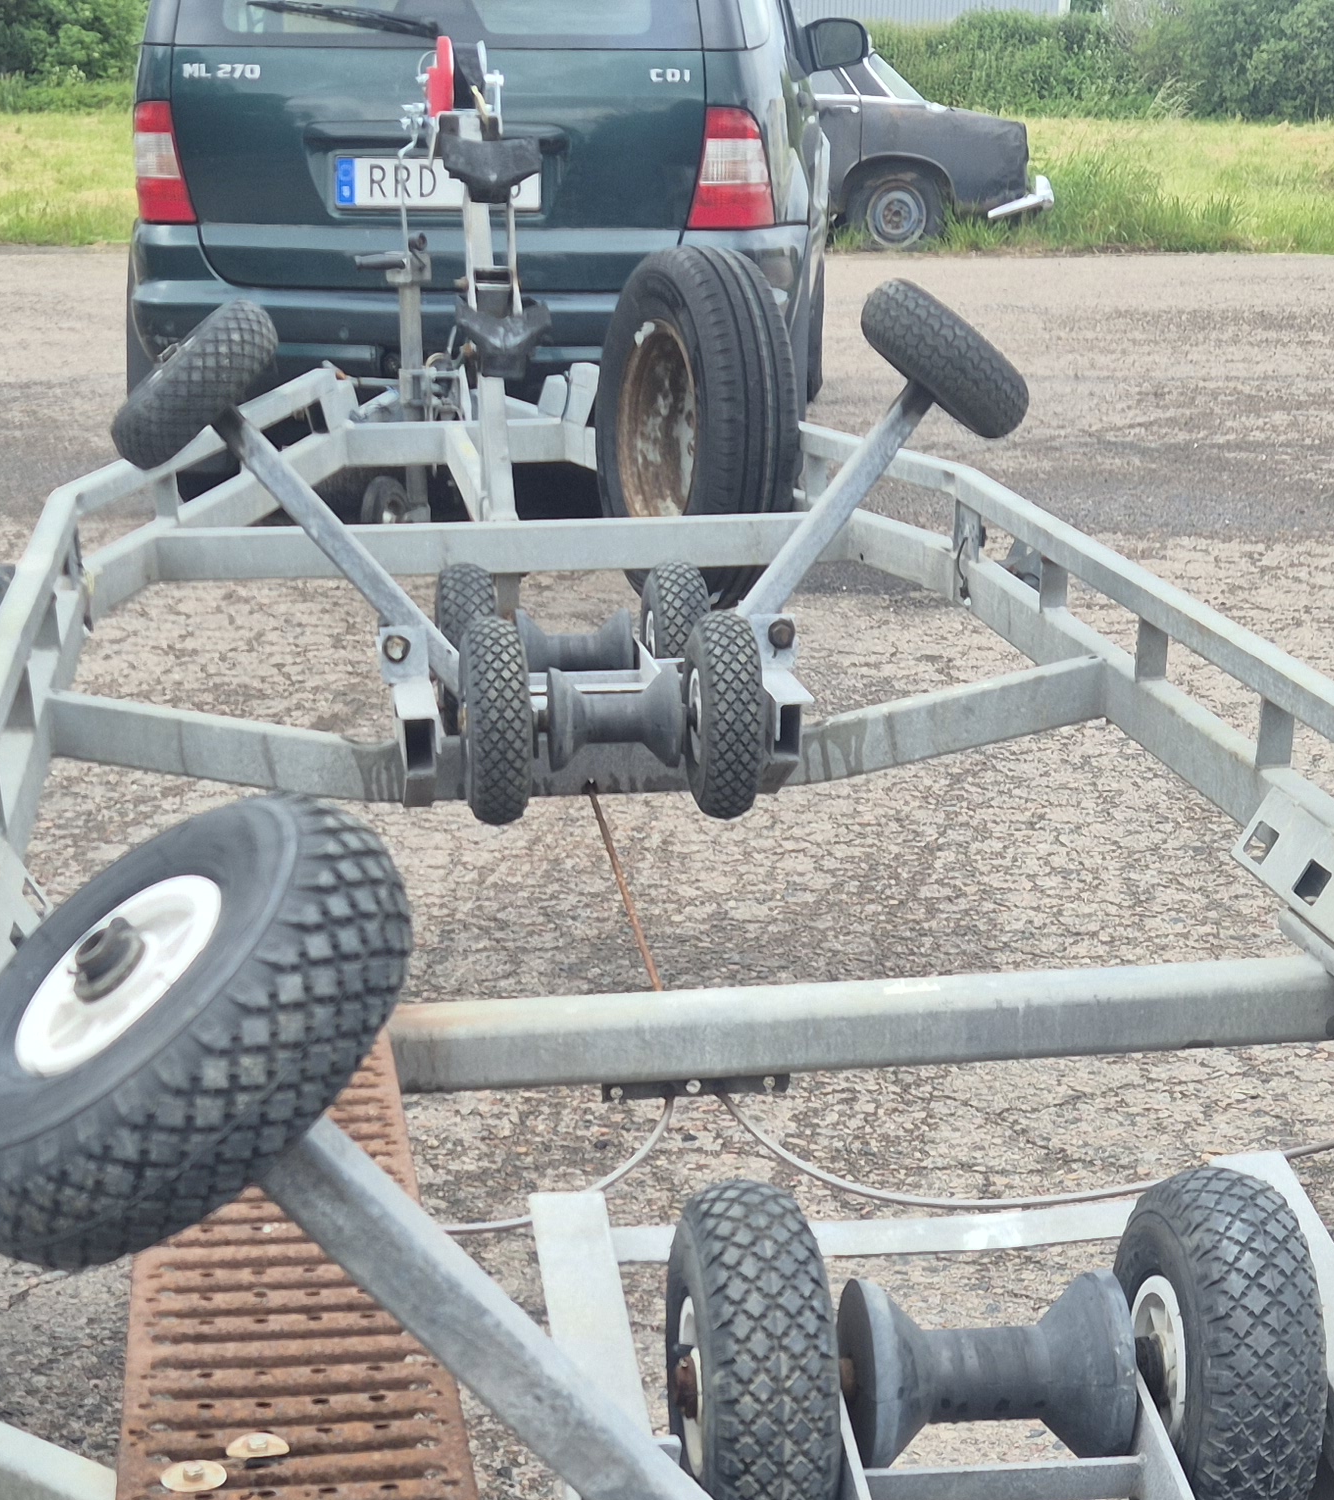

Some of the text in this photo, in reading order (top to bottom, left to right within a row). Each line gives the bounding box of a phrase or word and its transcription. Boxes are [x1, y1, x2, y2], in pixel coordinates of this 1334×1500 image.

[182, 63, 261, 80] ML 270
[649, 68, 691, 83] CDI
[369, 163, 437, 198] RRD
